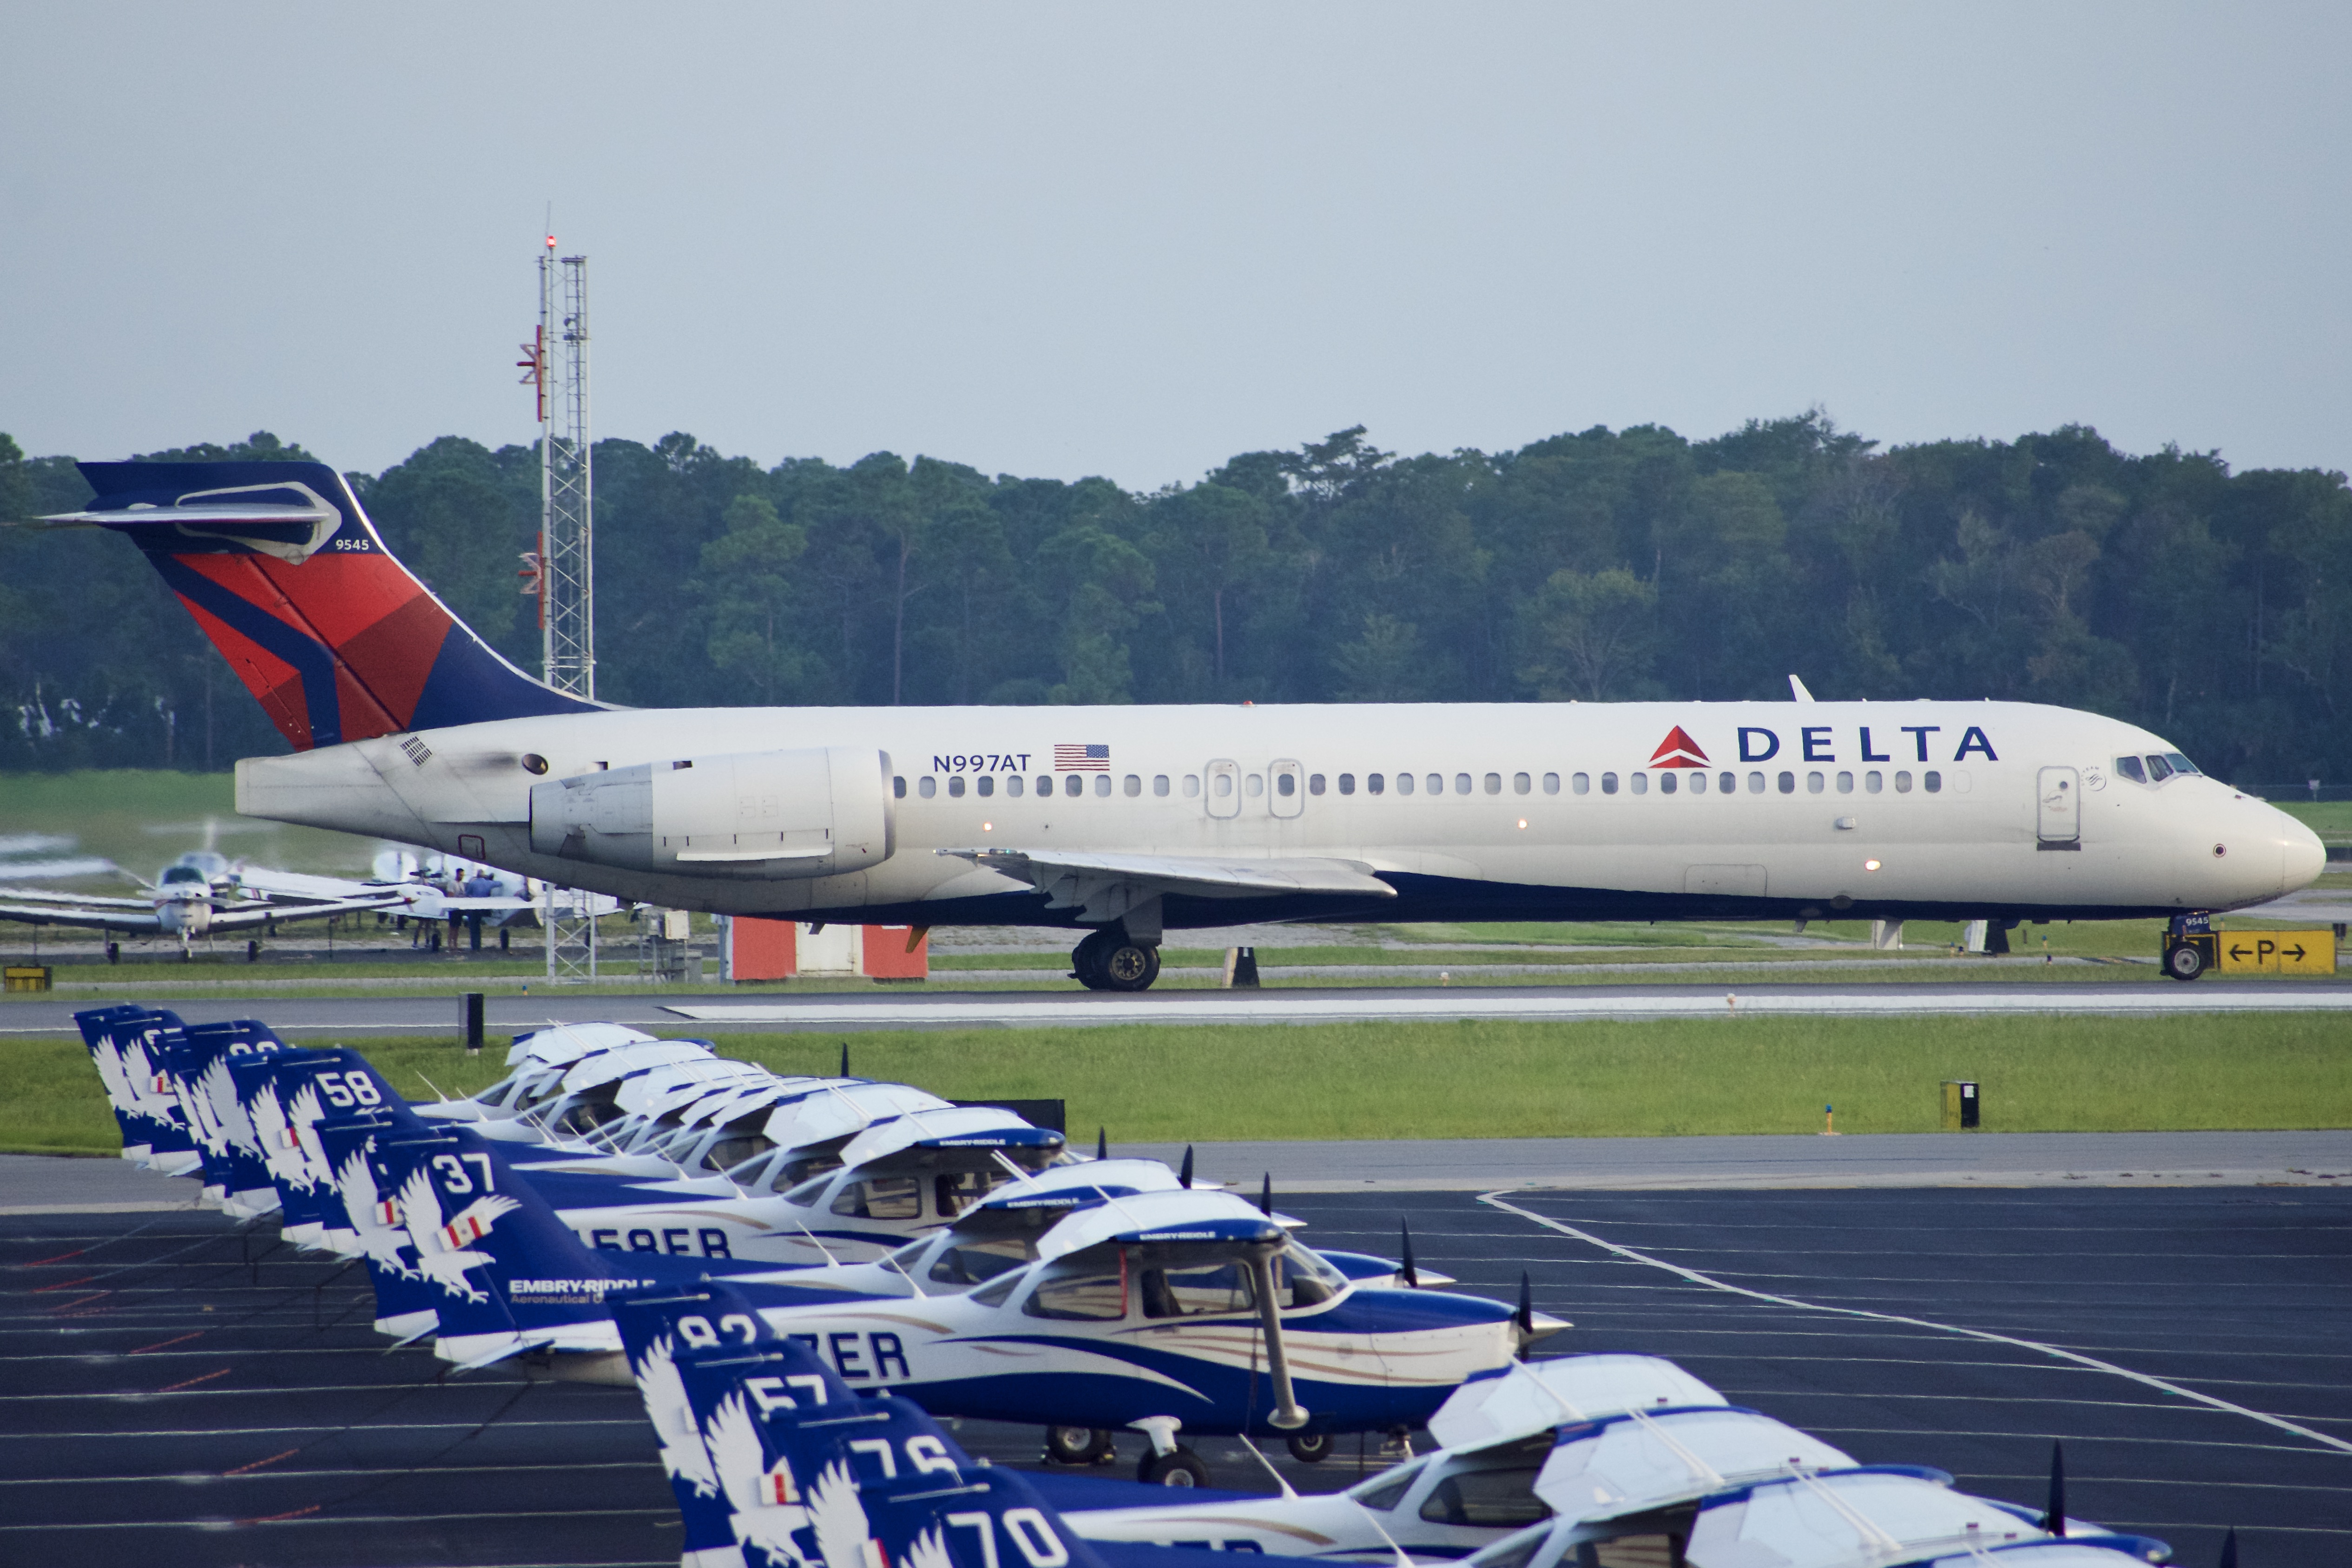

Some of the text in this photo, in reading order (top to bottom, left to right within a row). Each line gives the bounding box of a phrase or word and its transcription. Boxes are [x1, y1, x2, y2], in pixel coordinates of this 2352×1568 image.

[336, 539, 369, 550] 9545
[1737, 726, 1998, 762] DELTA
[934, 754, 1031, 772] N997AT
[2186, 917, 2208, 926] 9545
[2258, 940, 2275, 965] P
[315, 1070, 382, 1107] 58
[432, 1153, 494, 1194] 37
[572, 1228, 733, 1258] 58ER
[511, 1293, 589, 1304] Aeronautical
[945, 1508, 1069, 1568] 70
